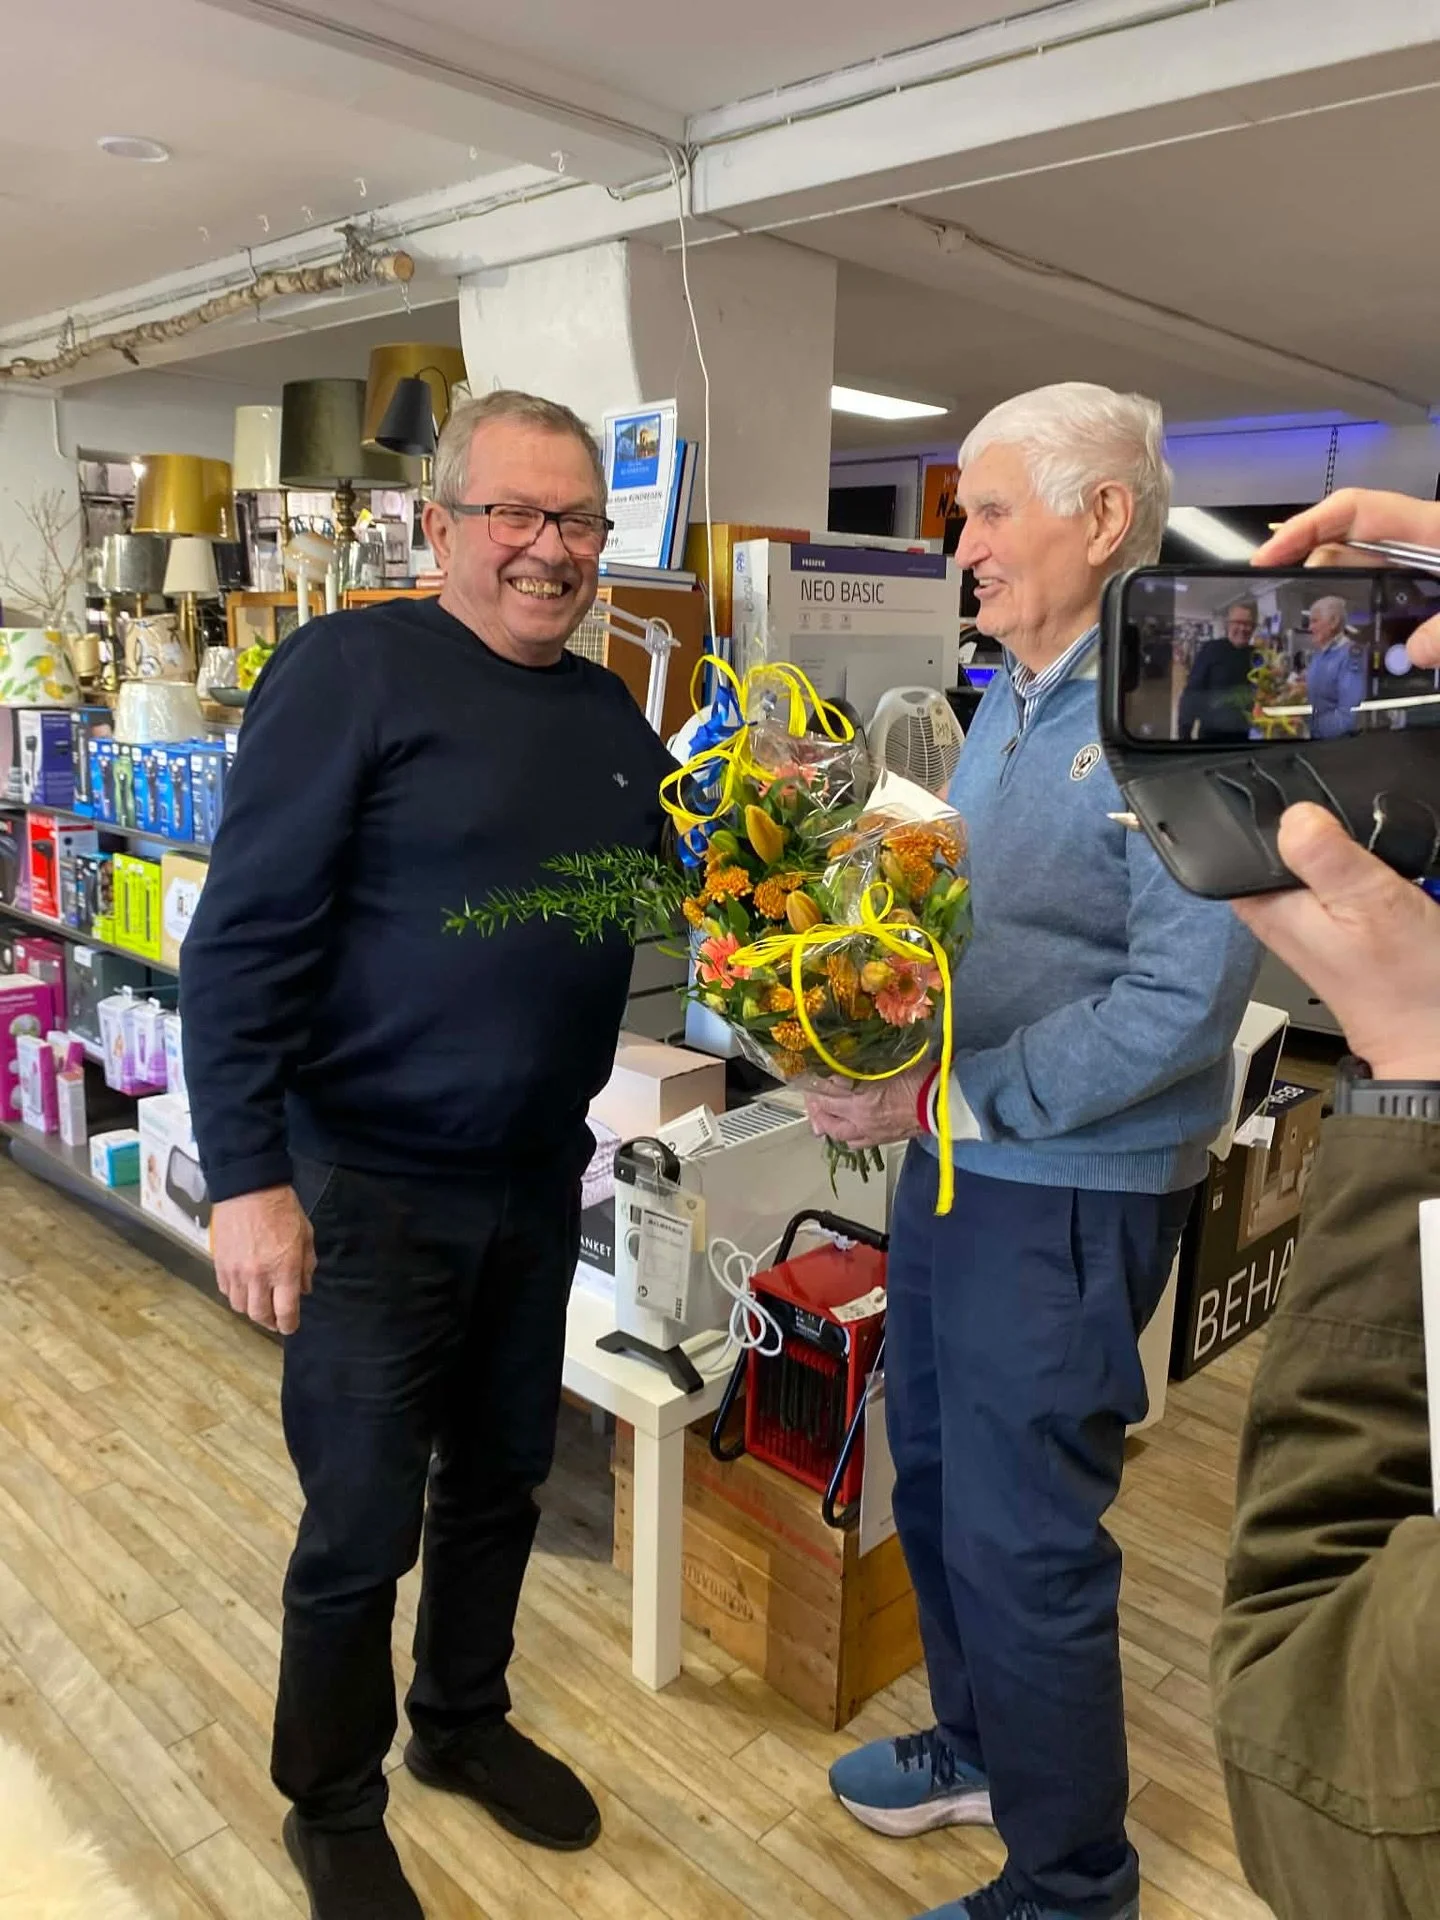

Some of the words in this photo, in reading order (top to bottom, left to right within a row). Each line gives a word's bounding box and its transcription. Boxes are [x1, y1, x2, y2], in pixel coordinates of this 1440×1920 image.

[800, 579, 835, 602] NEO
[840, 582, 885, 604] BASIC
[1193, 1236, 1295, 1361] BEHA
